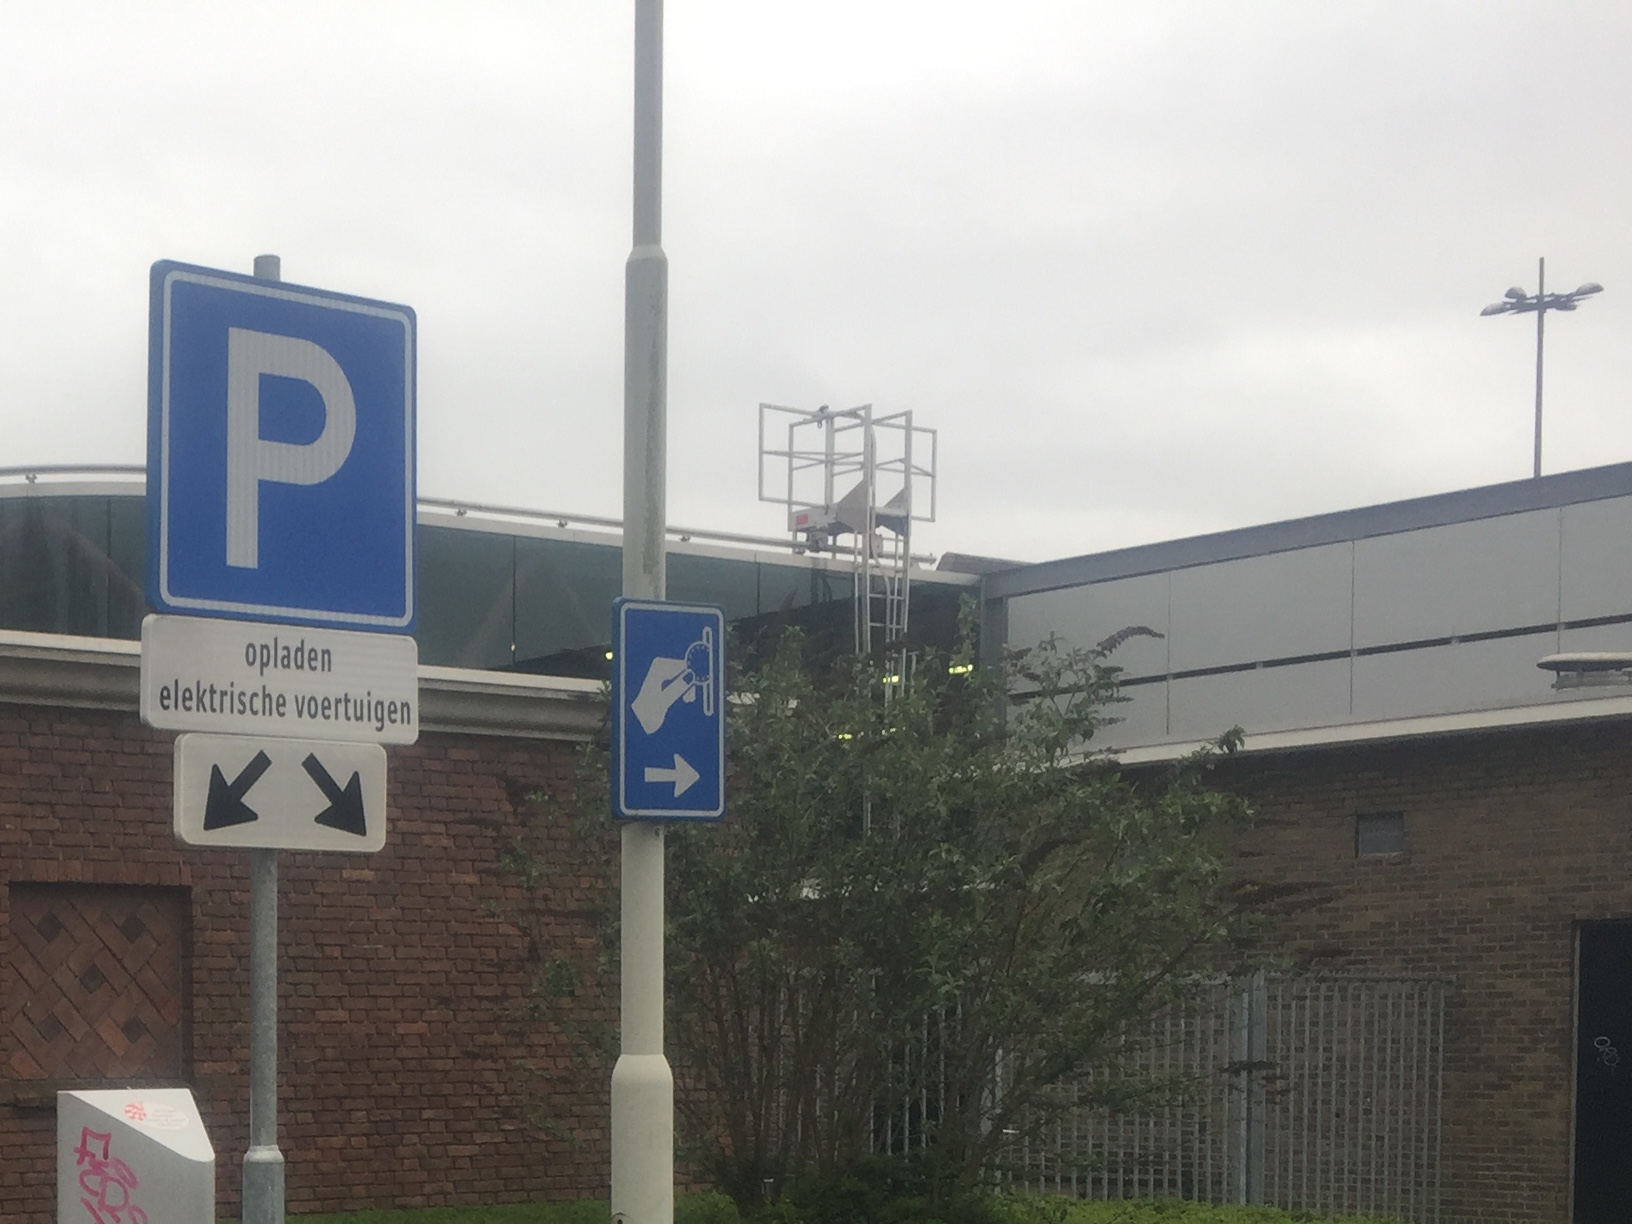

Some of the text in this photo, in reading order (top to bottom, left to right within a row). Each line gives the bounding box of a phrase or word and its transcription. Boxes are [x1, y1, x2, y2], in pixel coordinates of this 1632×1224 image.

[226, 327, 357, 569] P
[244, 636, 333, 676] opladen
[159, 678, 412, 732] elektrische voertuigen
